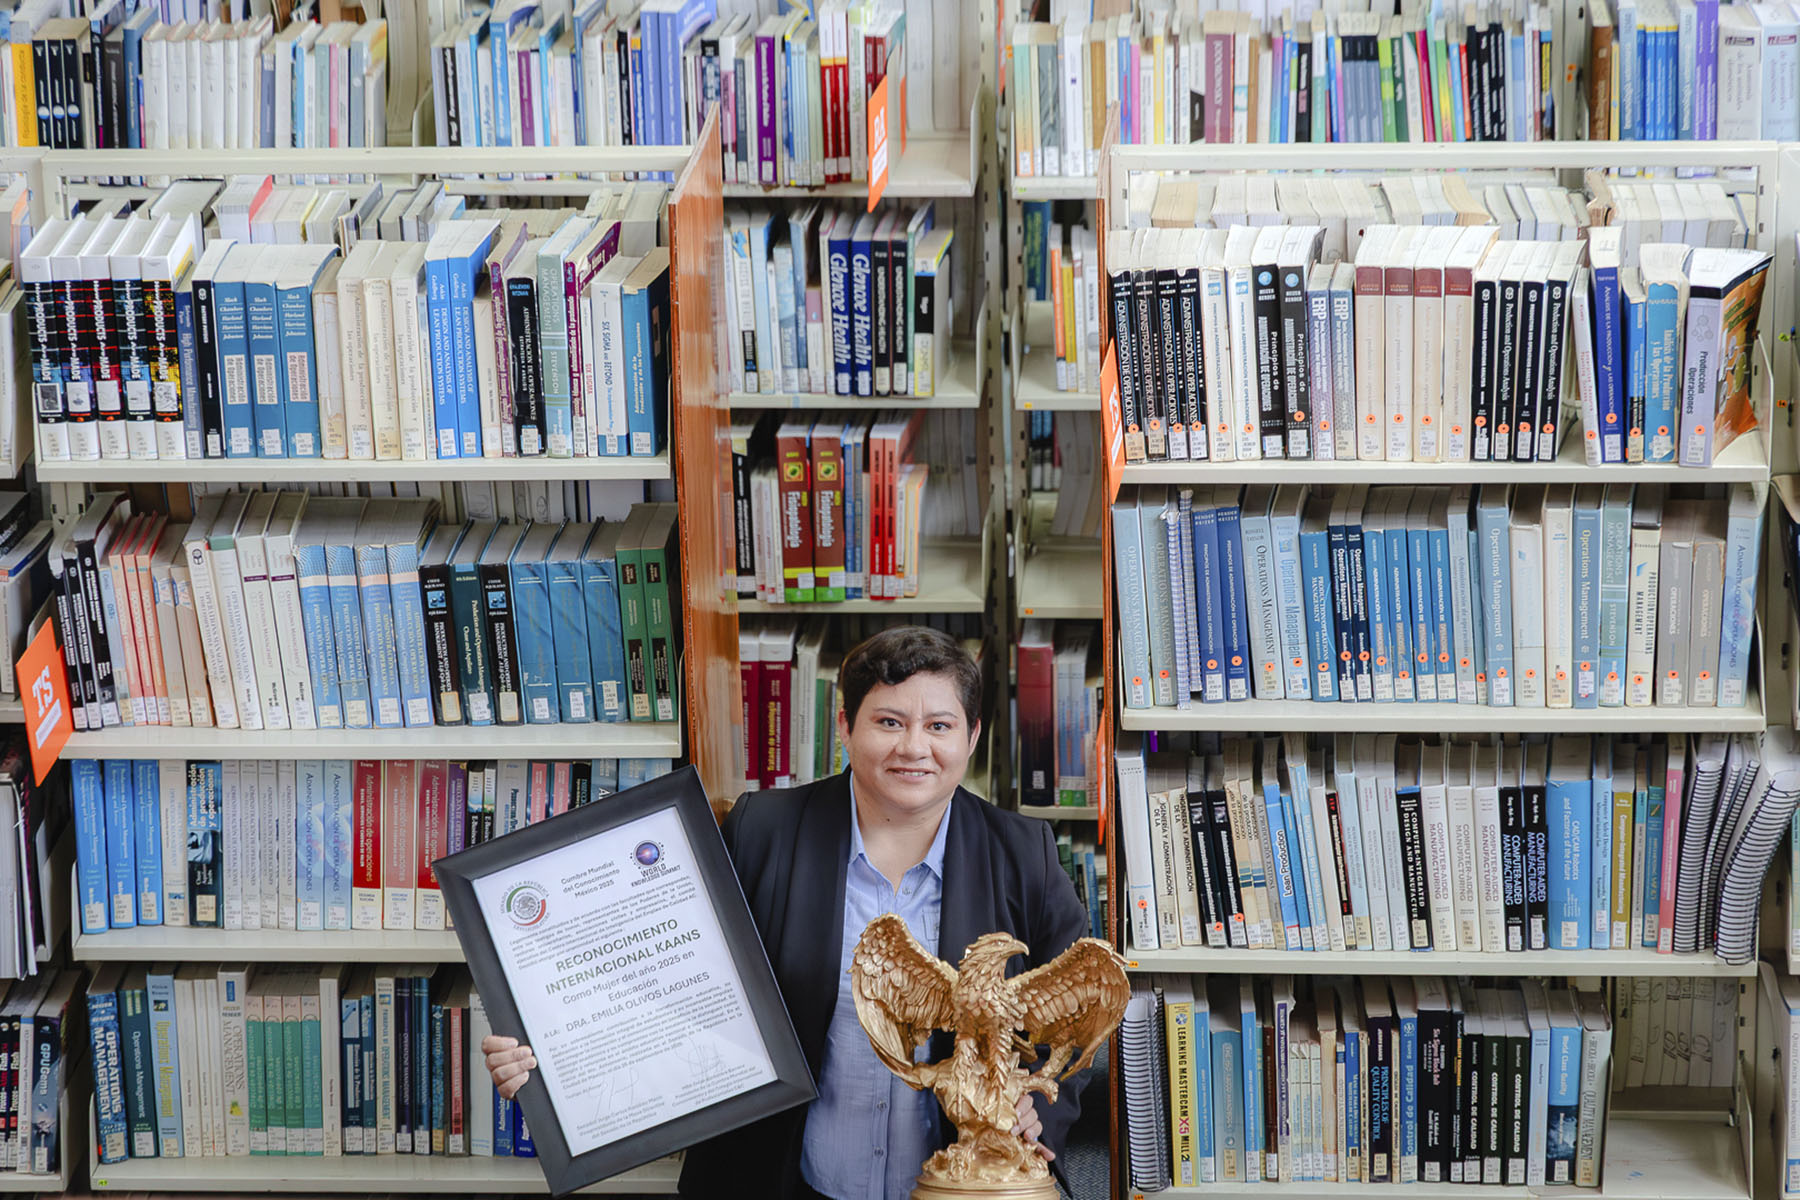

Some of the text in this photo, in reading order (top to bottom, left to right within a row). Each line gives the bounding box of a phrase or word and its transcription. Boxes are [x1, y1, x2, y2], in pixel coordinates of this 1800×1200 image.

[541, 268, 552, 331] MANAGEMENT
[550, 268, 561, 323] OPERATIONS
[830, 253, 851, 364] Glencoe Health
[852, 254, 871, 365] Glencoe Health
[1312, 297, 1326, 319] ERP
[1334, 297, 1348, 319] ERP
[34, 302, 51, 382] PRODUCTS MADE
[65, 301, 81, 381] PRODUCTS MADE
[93, 300, 110, 379] PRODUCTS MADE
[125, 300, 141, 379] PRODUCTS MADE
[154, 301, 169, 381] PRODUCTS MADE
[601, 321, 610, 331] SIX
[602, 332, 611, 351] SIGMA
[1118, 300, 1130, 375] ADMINISTRACIÓN DE
[1138, 299, 1151, 373] ADMINISTRACIÓN DE
[1161, 298, 1174, 373] ADMINISTRACIÓN DE
[1182, 297, 1194, 371] ADMINISTRACIÓN DE
[550, 352, 559, 394] STEVENSON
[603, 361, 613, 386] BEYOND
[1268, 331, 1279, 390] Principios de
[1296, 333, 1305, 392] Principios de
[1686, 367, 1697, 414] Operaciones
[1698, 351, 1709, 394] Producción
[1606, 522, 1616, 583] MANAGEMENT
[1615, 522, 1625, 576] OPERATIONS
[1128, 545, 1144, 673] OPERATIONS MANAGEMENT
[1155, 542, 1172, 669] OPERATIONS MANAGEMENT
[1256, 545, 1274, 655] OPERATIONS MANAGEMENT
[1280, 559, 1301, 659] Operations Management
[1338, 548, 1349, 621] Operations Management
[1354, 548, 1366, 621] Operations Management
[1490, 528, 1503, 637] Operations Management
[1579, 529, 1591, 639] Operations Management
[1729, 545, 1746, 668] ADMINISTRACIÓN DE OPERACIONES
[1634, 592, 1644, 634] MANAGEMENT
[32, 665, 53, 718] TS
[188, 764, 198, 827] Administración
[196, 768, 207, 827] de producción
[206, 769, 216, 819] operaciones
[305, 773, 314, 832] ADMINISTRACIÓN
[333, 773, 342, 833] ADMINISTRACIÓN
[366, 774, 374, 827] Administración
[1174, 804, 1180, 823] DE LA
[306, 834, 312, 843] DE
[364, 838, 373, 882] operaciones
[1183, 837, 1194, 892] ADMINISTRACIÓN
[1277, 829, 1294, 897] Lean Production
[1403, 812, 1414, 862] DESIGN AND
[1411, 812, 1425, 907] COMPUTER-INTEGRATED
[1527, 831, 1537, 903] MANUFACTURING
[1536, 832, 1546, 902] COMPUTER-AIDED
[560, 860, 614, 884] Cumbre Mundial
[562, 867, 620, 893] del Conocimiento
[574, 879, 614, 898] México 2025
[630, 864, 681, 887] KNOWLEDGE SUMMIT
[640, 863, 667, 877] WORLD
[1162, 841, 1173, 896] ADMINISTRACIÓN
[1503, 834, 1513, 905] MANUFACTURING
[1511, 835, 1522, 904] COMPUTER-AIDED
[544, 928, 701, 995] INTERNACIONAL KAANS
[555, 918, 679, 972] RECONOCIMIENTO
[562, 950, 695, 1005] Como Mujer del año 2025 en
[565, 970, 710, 1031] DRA. EMILIA OLIVOS LAGUNES
[607, 976, 659, 1002] Educación
[94, 1027, 111, 1121] MANAGEMENT
[106, 1031, 122, 1113] OPERATIONS
[132, 1031, 146, 1118] Operations Management
[155, 1021, 175, 1117] Operations Management
[223, 1020, 235, 1096] MANAGEMENT
[232, 1025, 246, 1090] OPERATIONS
[1177, 1027, 1190, 1153] LEARNING MASTERCAM X5 MILL
[1371, 1066, 1381, 1142] QUALITY CONTROL
[1381, 1066, 1390, 1124] PRINCIPLES OF
[1405, 1065, 1415, 1118] de Calidad
[1470, 1106, 1477, 1116] DE
[1490, 1072, 1498, 1106] CONTROL
[1490, 1107, 1497, 1117] DE
[1514, 1109, 1521, 1119] DE
[1470, 1118, 1478, 1149] CALIDAD
[1581, 1090, 1596, 1160] QUALITY MANAGEMENT
